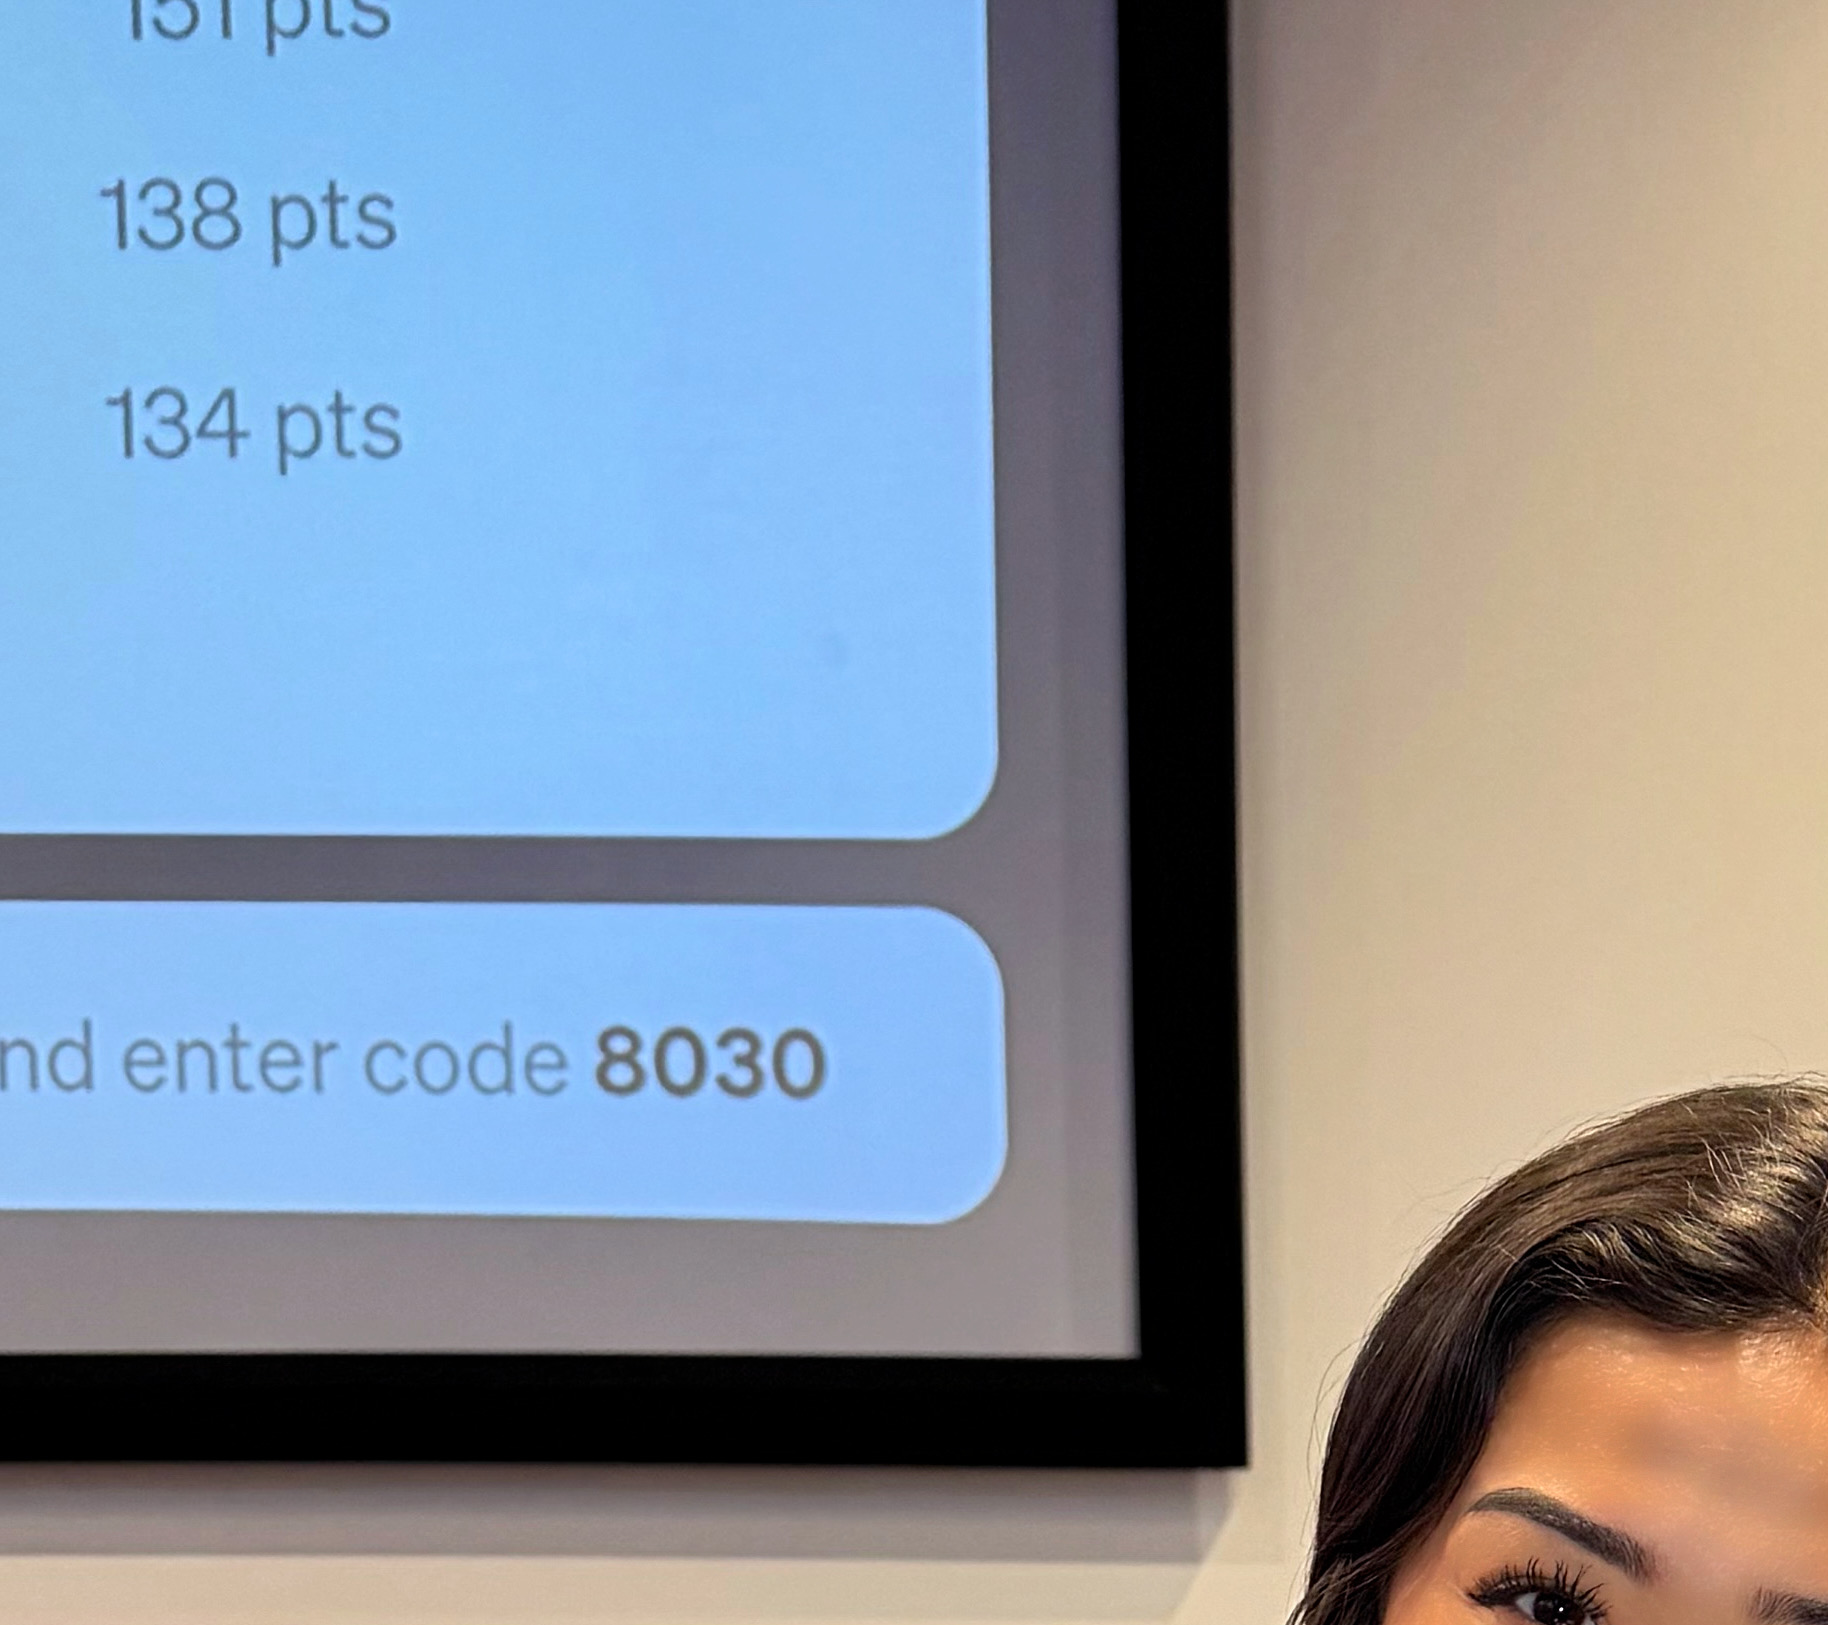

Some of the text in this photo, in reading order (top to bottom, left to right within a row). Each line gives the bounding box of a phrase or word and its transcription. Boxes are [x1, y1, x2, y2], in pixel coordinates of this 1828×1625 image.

[266, 0, 391, 57] pts
[100, 176, 398, 268] 138 pts
[105, 385, 402, 476] 134 pts
[122, 1023, 338, 1094] enter
[364, 1020, 569, 1096] code
[594, 1025, 826, 1098] 8030
